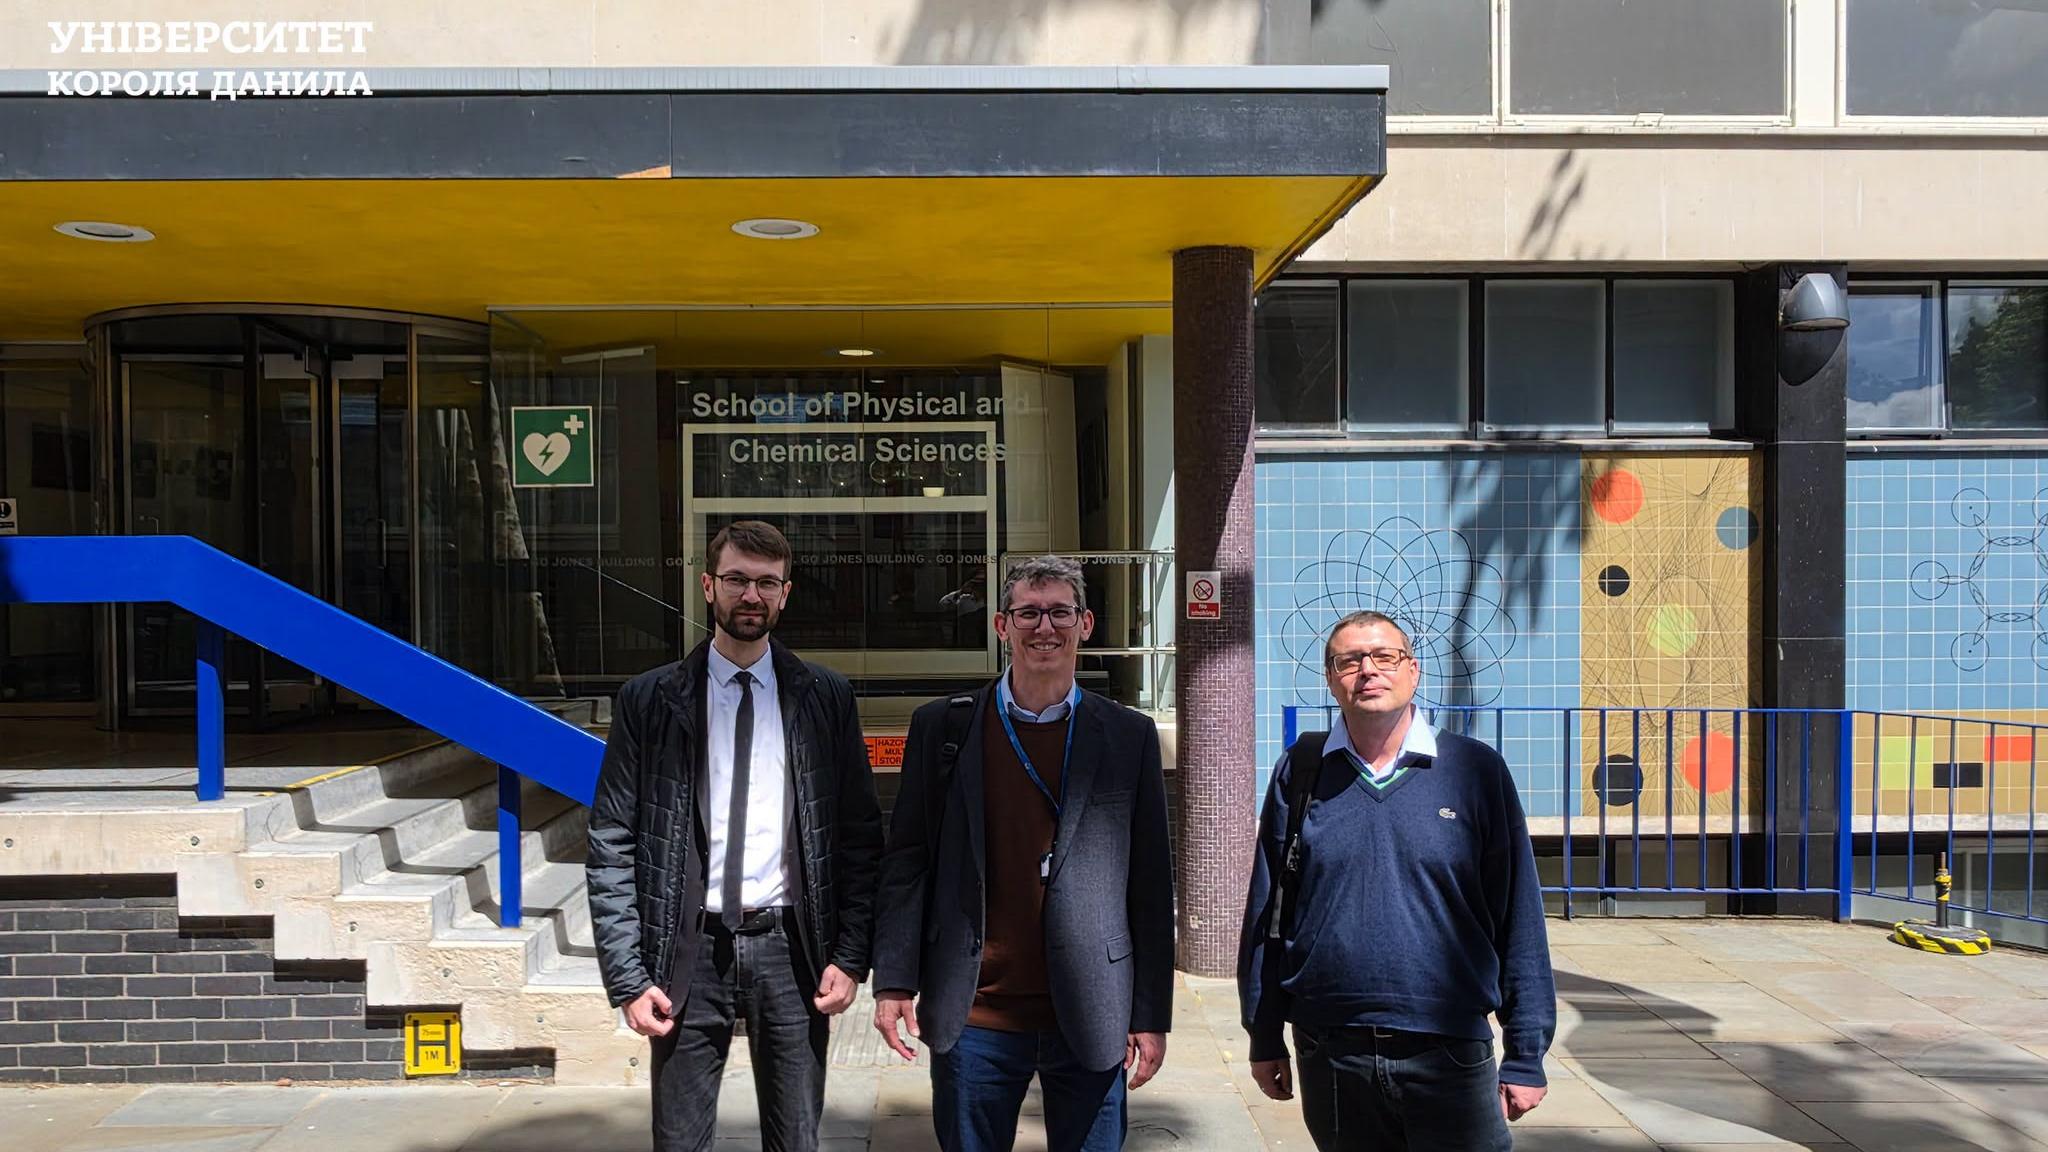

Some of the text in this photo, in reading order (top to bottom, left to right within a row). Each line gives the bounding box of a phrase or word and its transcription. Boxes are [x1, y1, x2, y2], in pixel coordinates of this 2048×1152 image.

[692, 391, 1029, 422] School of Physical and
[729, 437, 1006, 464] Chemical Sciences
[666, 557, 683, 567] GO
[800, 554, 818, 564] GO
[823, 554, 863, 564] JONES
[866, 554, 925, 564] BUILDING
[936, 554, 953, 564] GO
[957, 554, 997, 564] JONES
[1092, 556, 1132, 564] JONES
[425, 1050, 439, 1061] 1M
